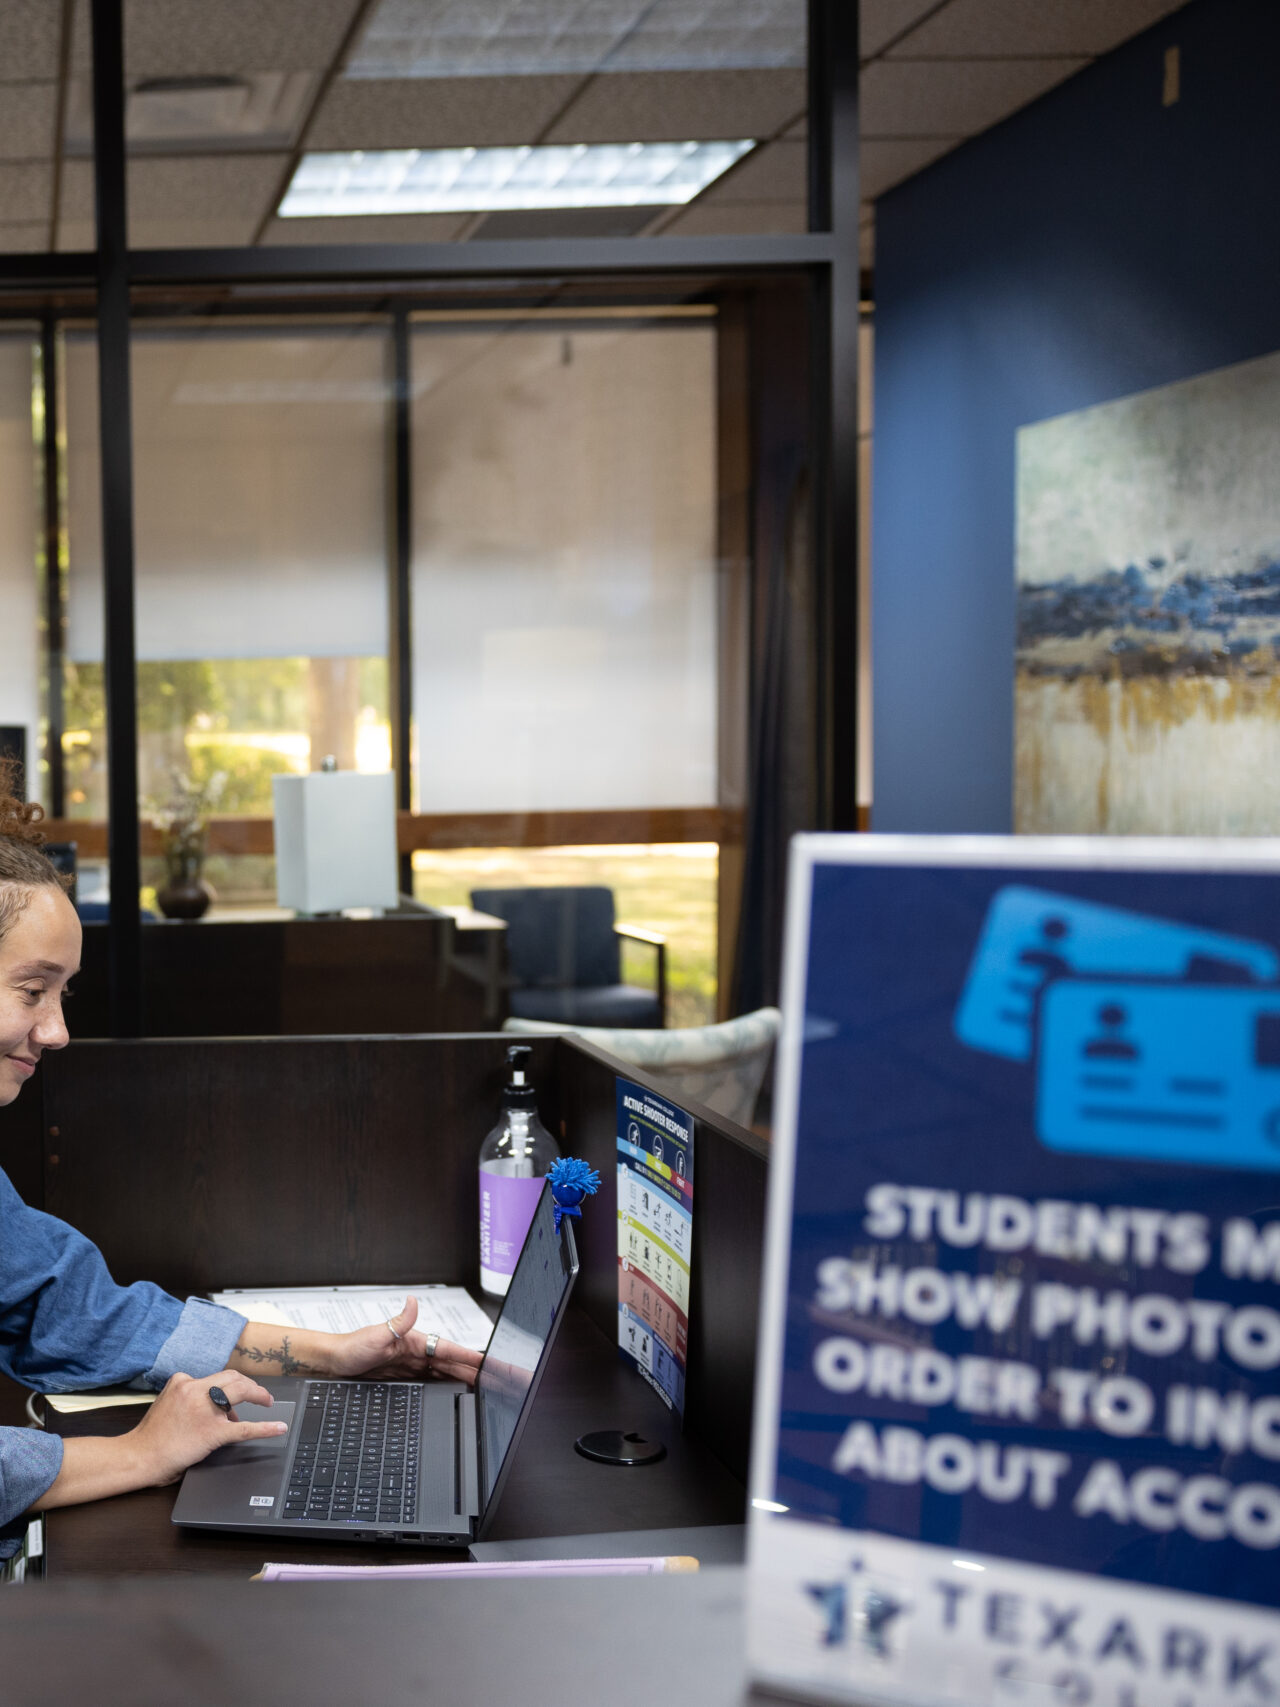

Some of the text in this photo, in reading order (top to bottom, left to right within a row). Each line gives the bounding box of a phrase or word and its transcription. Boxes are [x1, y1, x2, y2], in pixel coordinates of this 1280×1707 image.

[623, 1095, 644, 1114] ACTIVE
[643, 1104, 666, 1128] SHOOTER
[665, 1116, 689, 1143] RESPONSE
[865, 1183, 1211, 1275] STUDENTS
[816, 1256, 1280, 1371] SHOW PHOTO
[813, 1336, 1042, 1421] ORDER
[1050, 1366, 1155, 1438] TO
[833, 1420, 1280, 1551] ABOUT ACCO
[933, 1579, 1278, 1699] TEXARK
